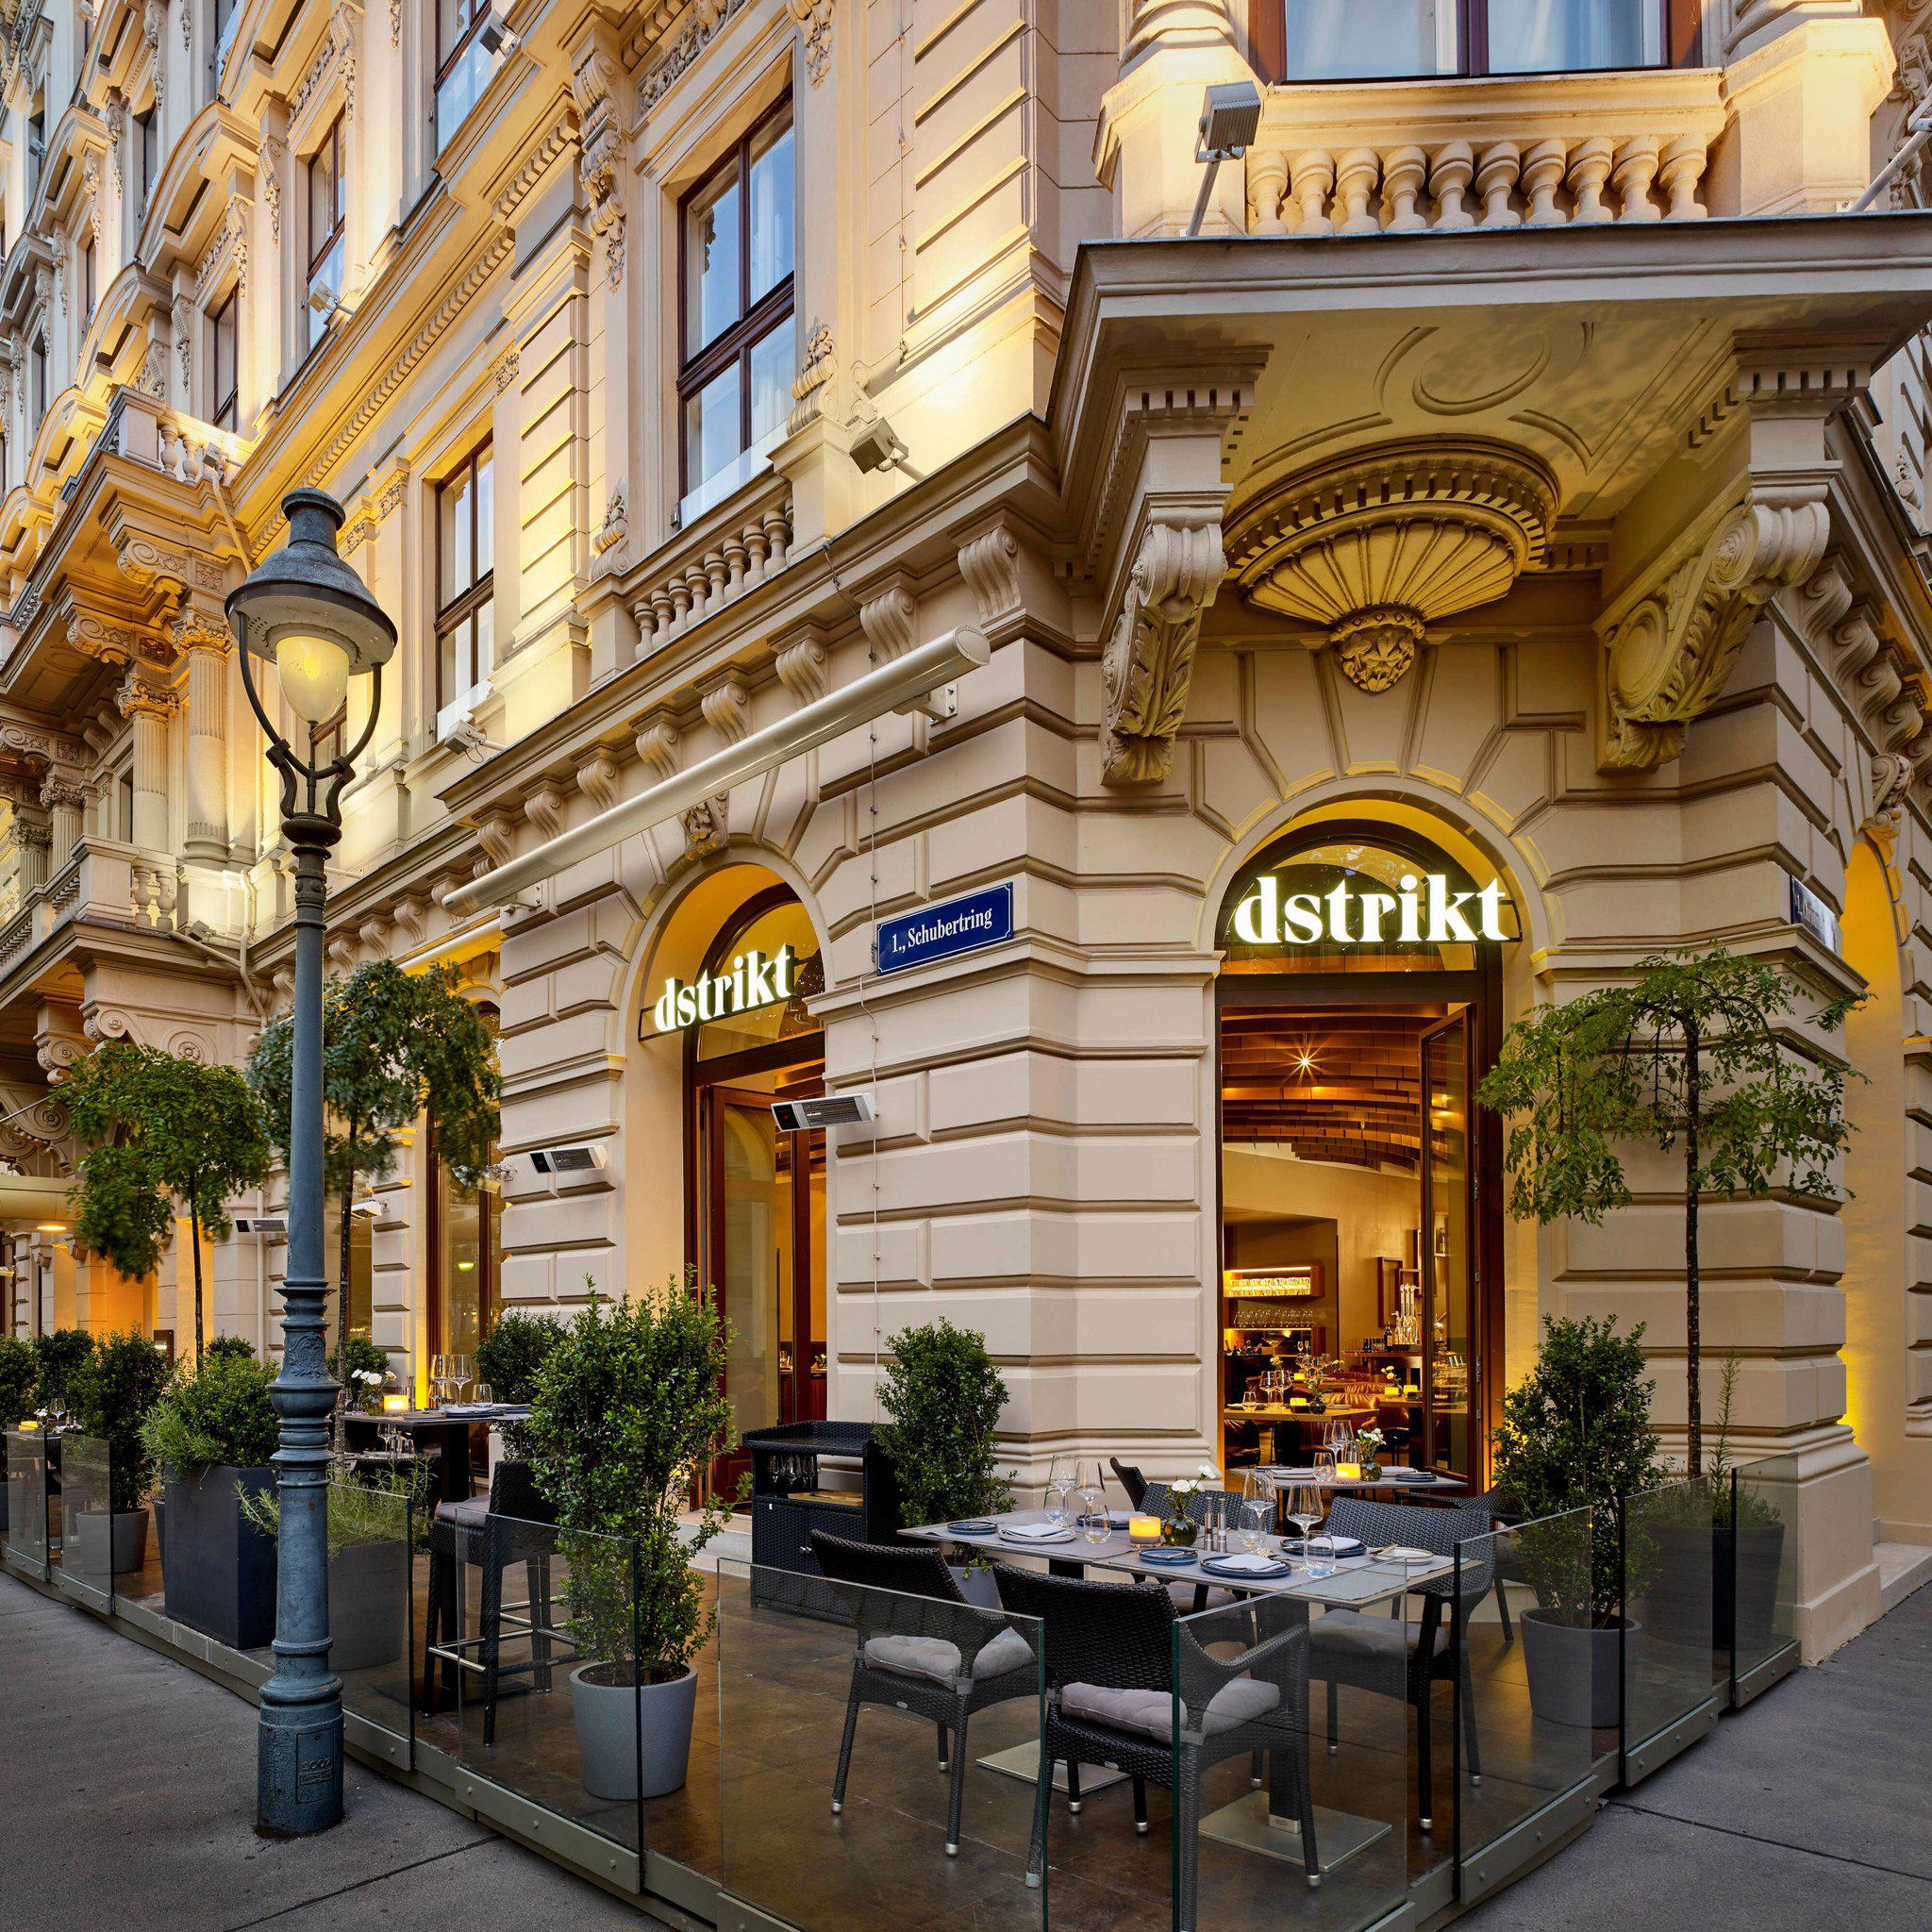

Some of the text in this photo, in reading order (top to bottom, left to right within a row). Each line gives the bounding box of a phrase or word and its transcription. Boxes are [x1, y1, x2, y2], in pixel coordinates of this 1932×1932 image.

[891, 908, 993, 954] 1., Schubertring
[1234, 874, 1510, 943] dstrikt
[655, 943, 792, 1032] dstrikt
